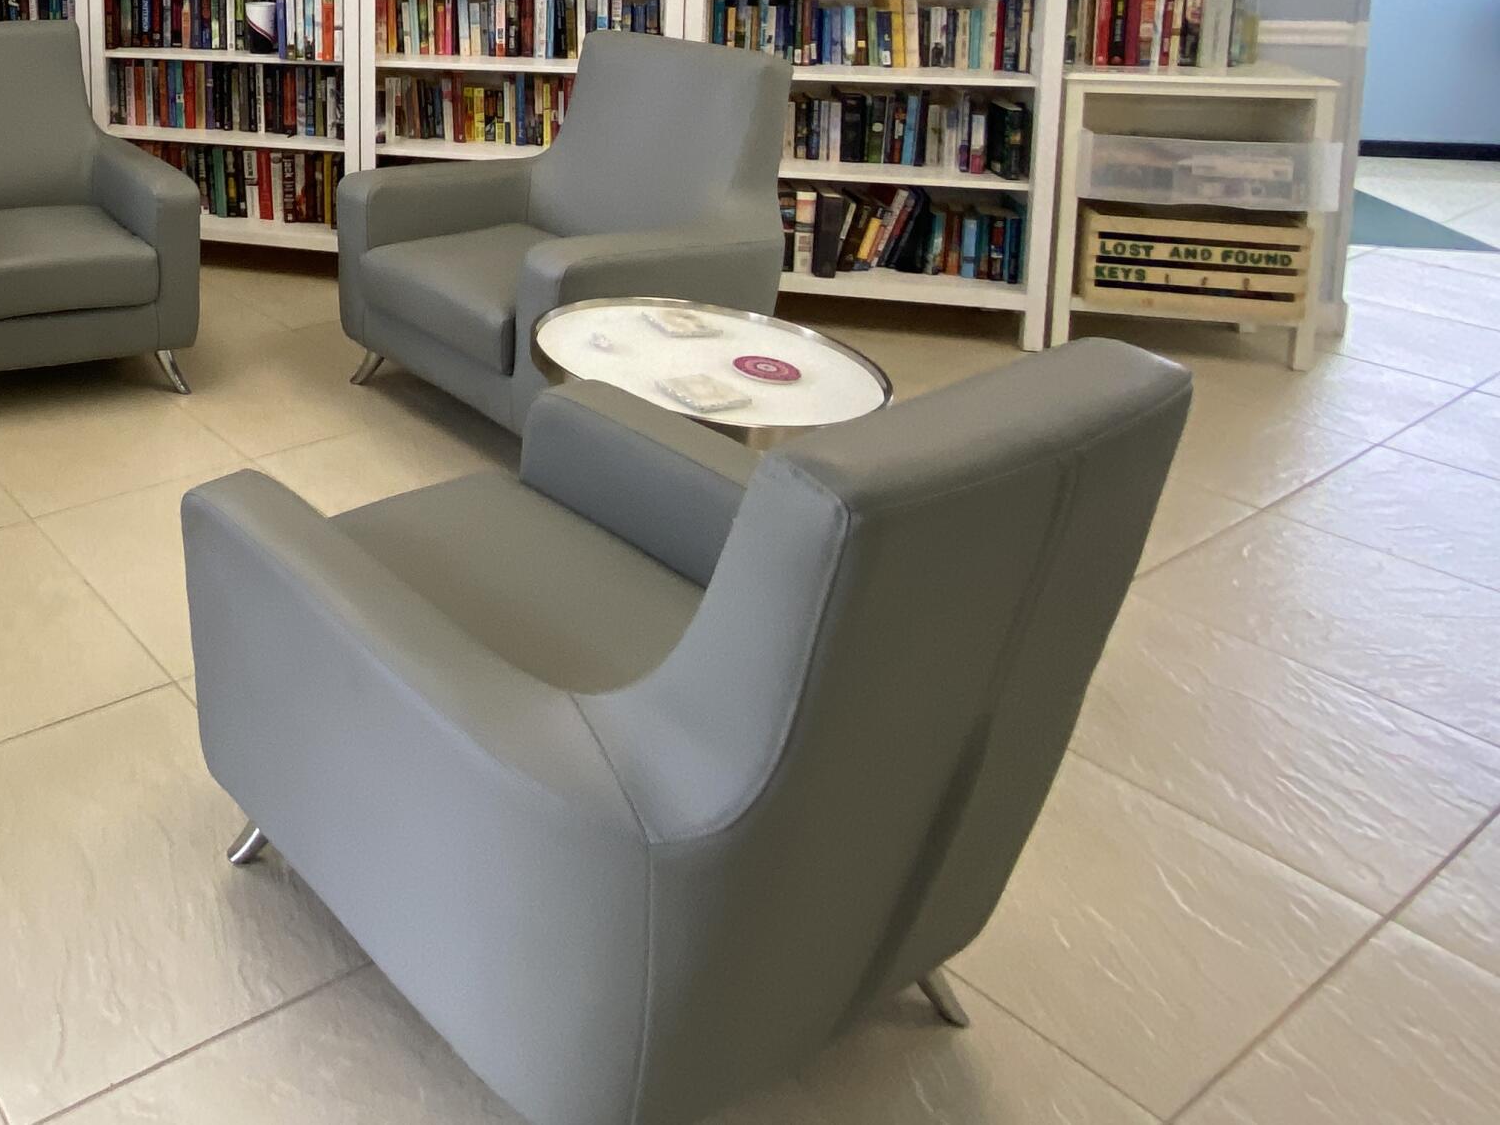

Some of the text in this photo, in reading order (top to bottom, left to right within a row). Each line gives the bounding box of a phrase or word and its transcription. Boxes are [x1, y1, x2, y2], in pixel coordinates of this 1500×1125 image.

[1100, 241, 1292, 267] LOST AND FOUND
[1094, 265, 1146, 282] KEYS
